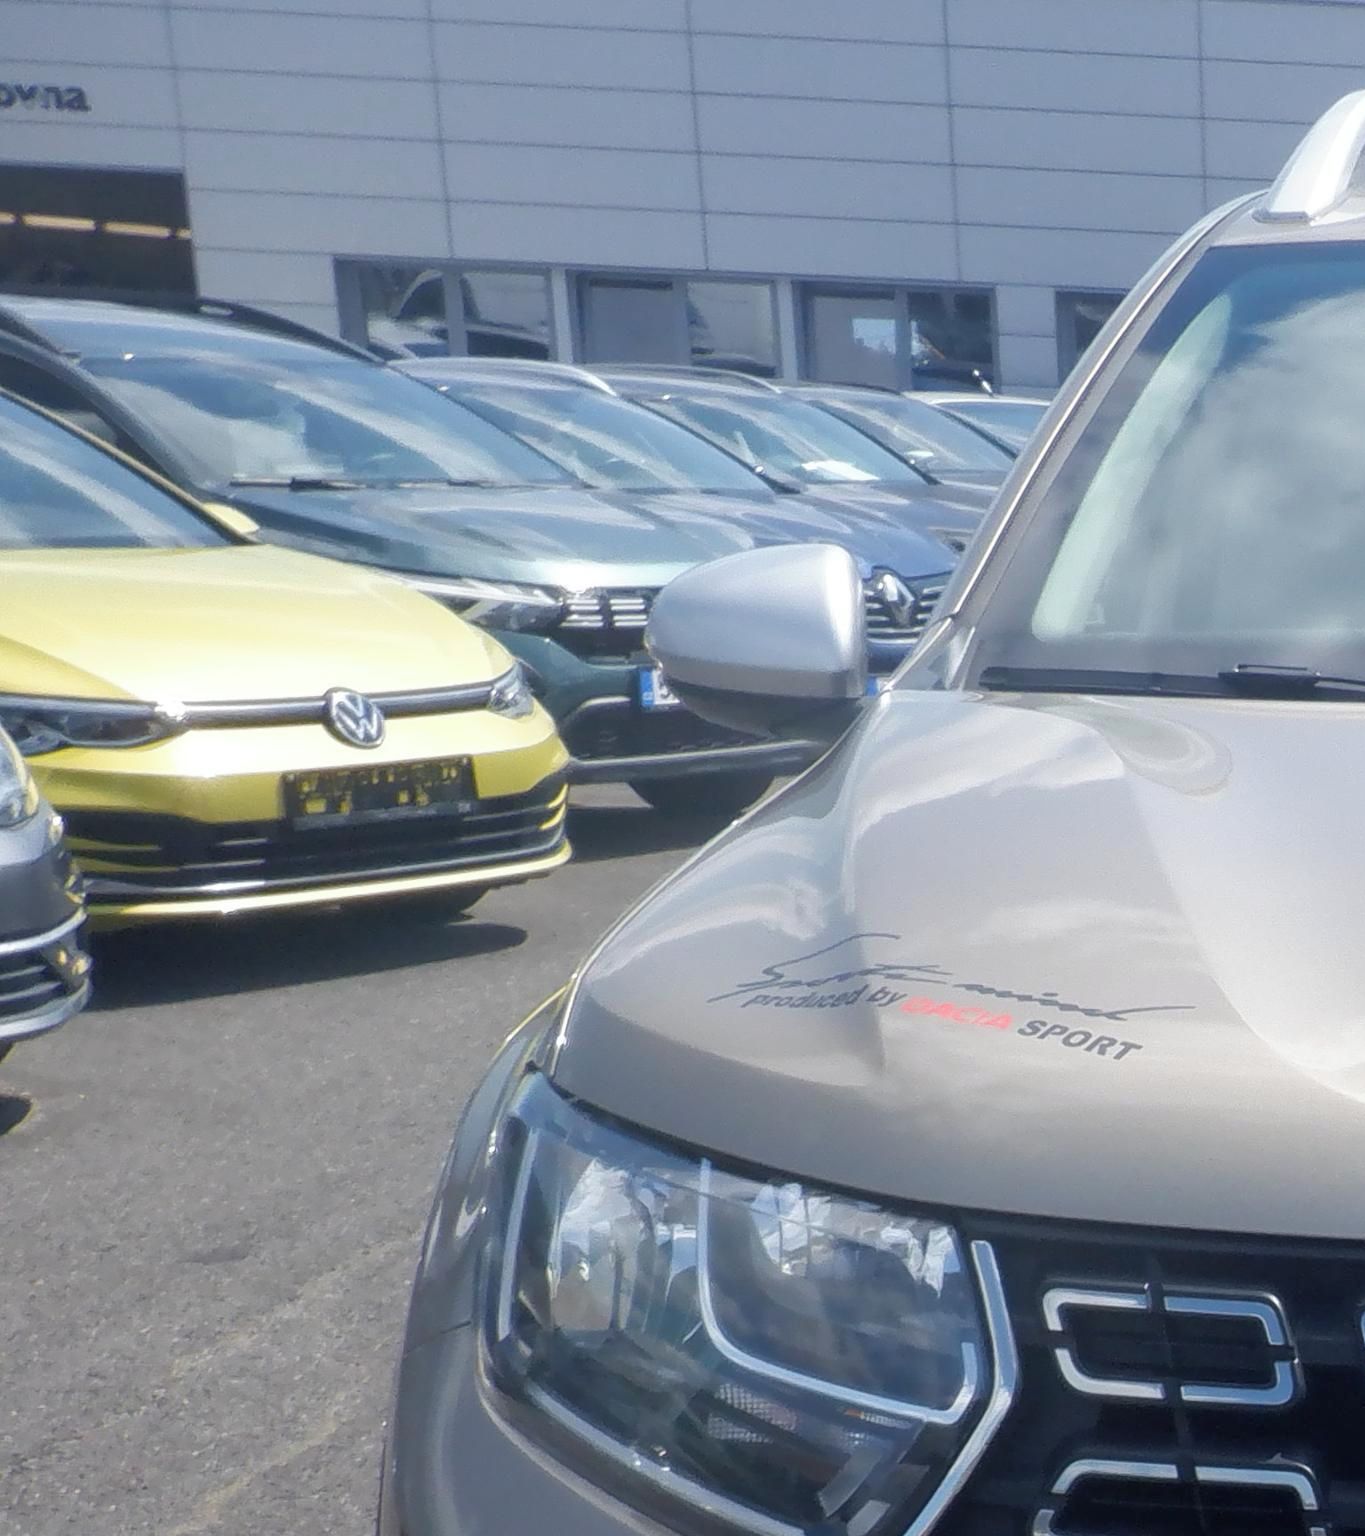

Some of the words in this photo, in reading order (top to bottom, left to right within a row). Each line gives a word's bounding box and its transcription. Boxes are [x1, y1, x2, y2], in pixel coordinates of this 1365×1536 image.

[741, 983, 869, 1008] produced
[866, 985, 908, 1007] by
[1017, 1019, 1143, 1061] SPORT
